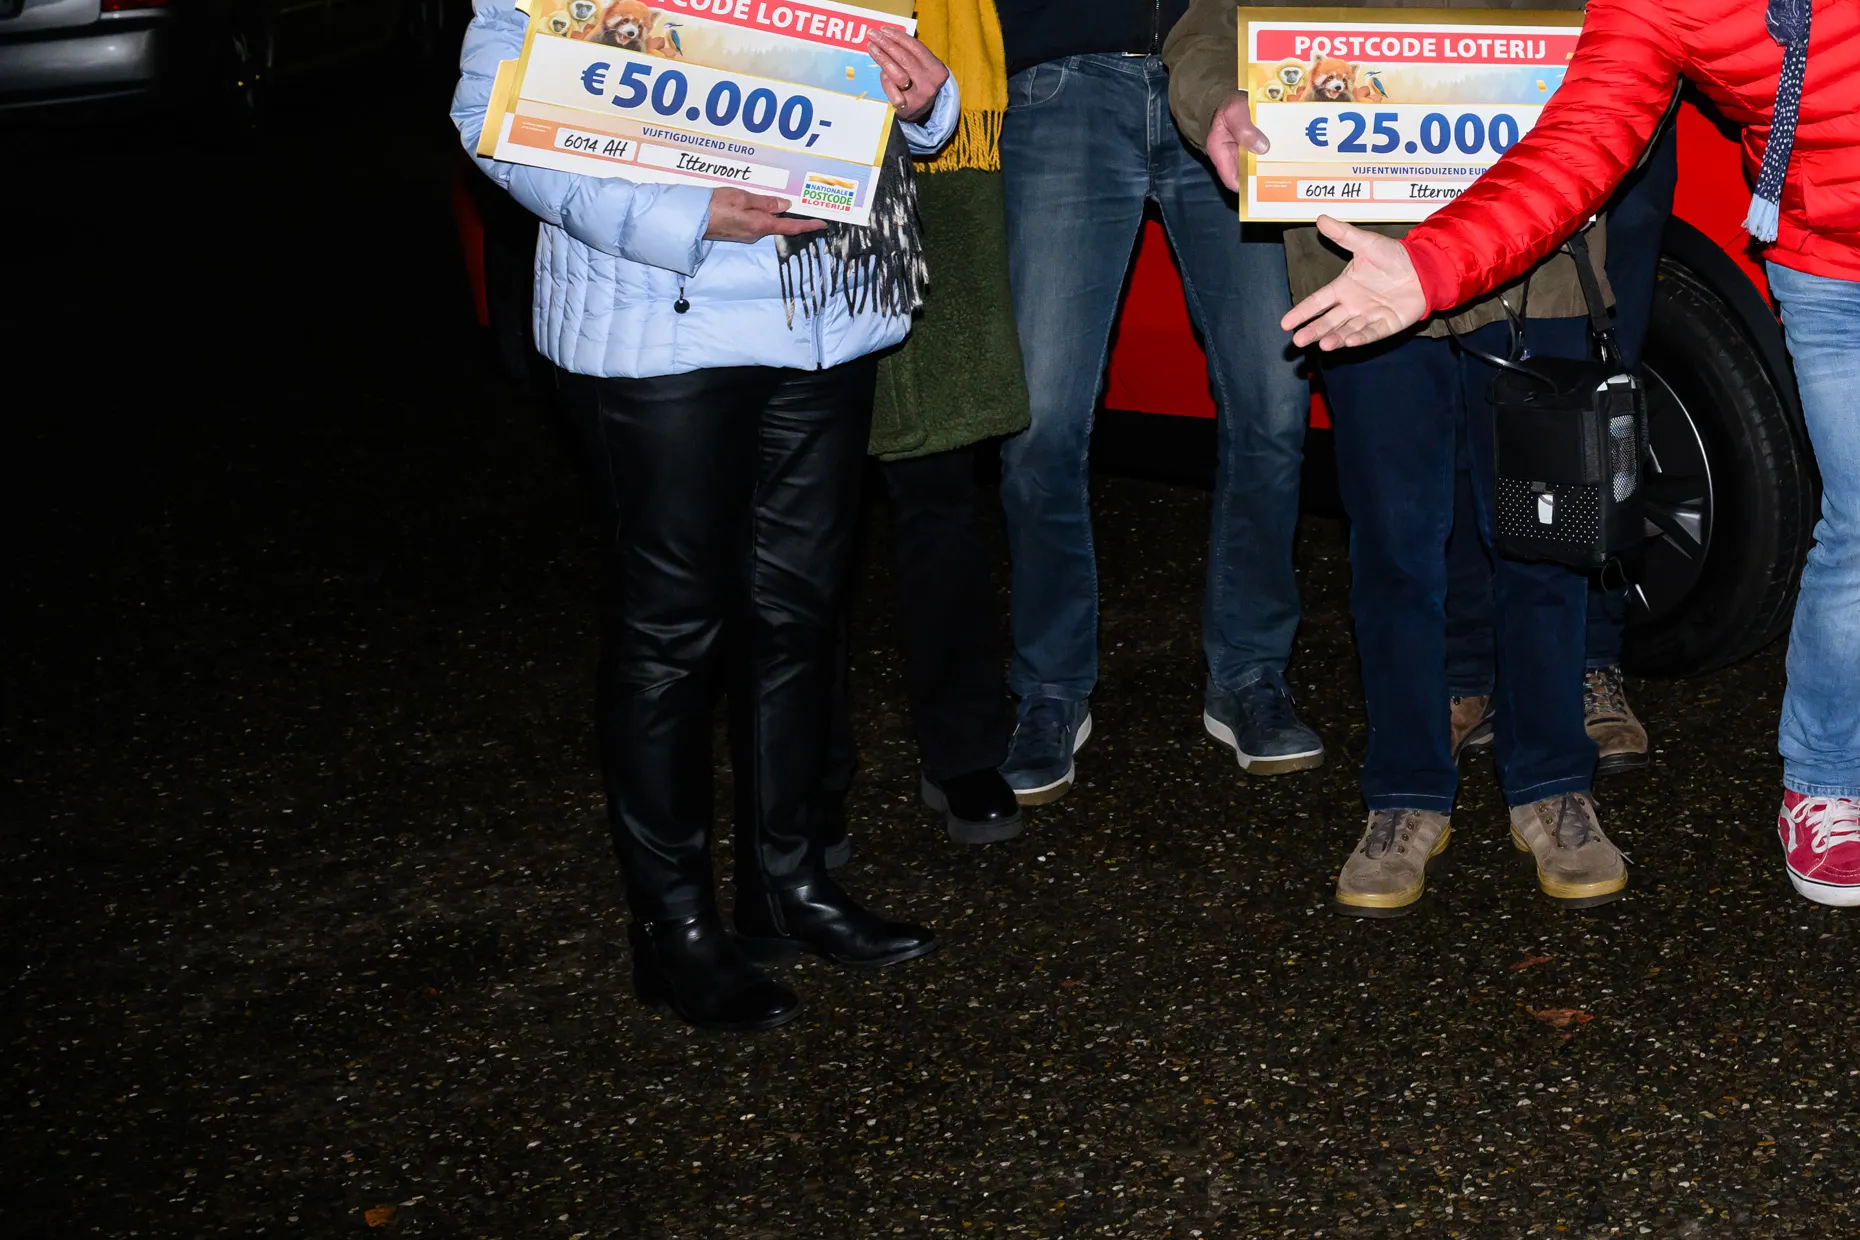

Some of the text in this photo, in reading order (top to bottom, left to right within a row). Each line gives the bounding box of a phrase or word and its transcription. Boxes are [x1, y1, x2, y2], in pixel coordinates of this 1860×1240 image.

[756, 3, 868, 44] LOTERIJ
[1295, 36, 1546, 59] POSTCODE LOTERIJ
[564, 135, 628, 158] 6014 AH
[642, 127, 755, 156] VIJFTIGDUIZEND EURO
[676, 153, 752, 181] Ittervoort
[1352, 166, 1467, 175] VIJFENTWINTIGDUIZEND
[803, 189, 852, 205] POSTCODE
[809, 185, 849, 196] NATIONALE
[1306, 184, 1335, 198] 6014
[1341, 183, 1361, 198] AH
[806, 200, 846, 212] LOTERIJ
